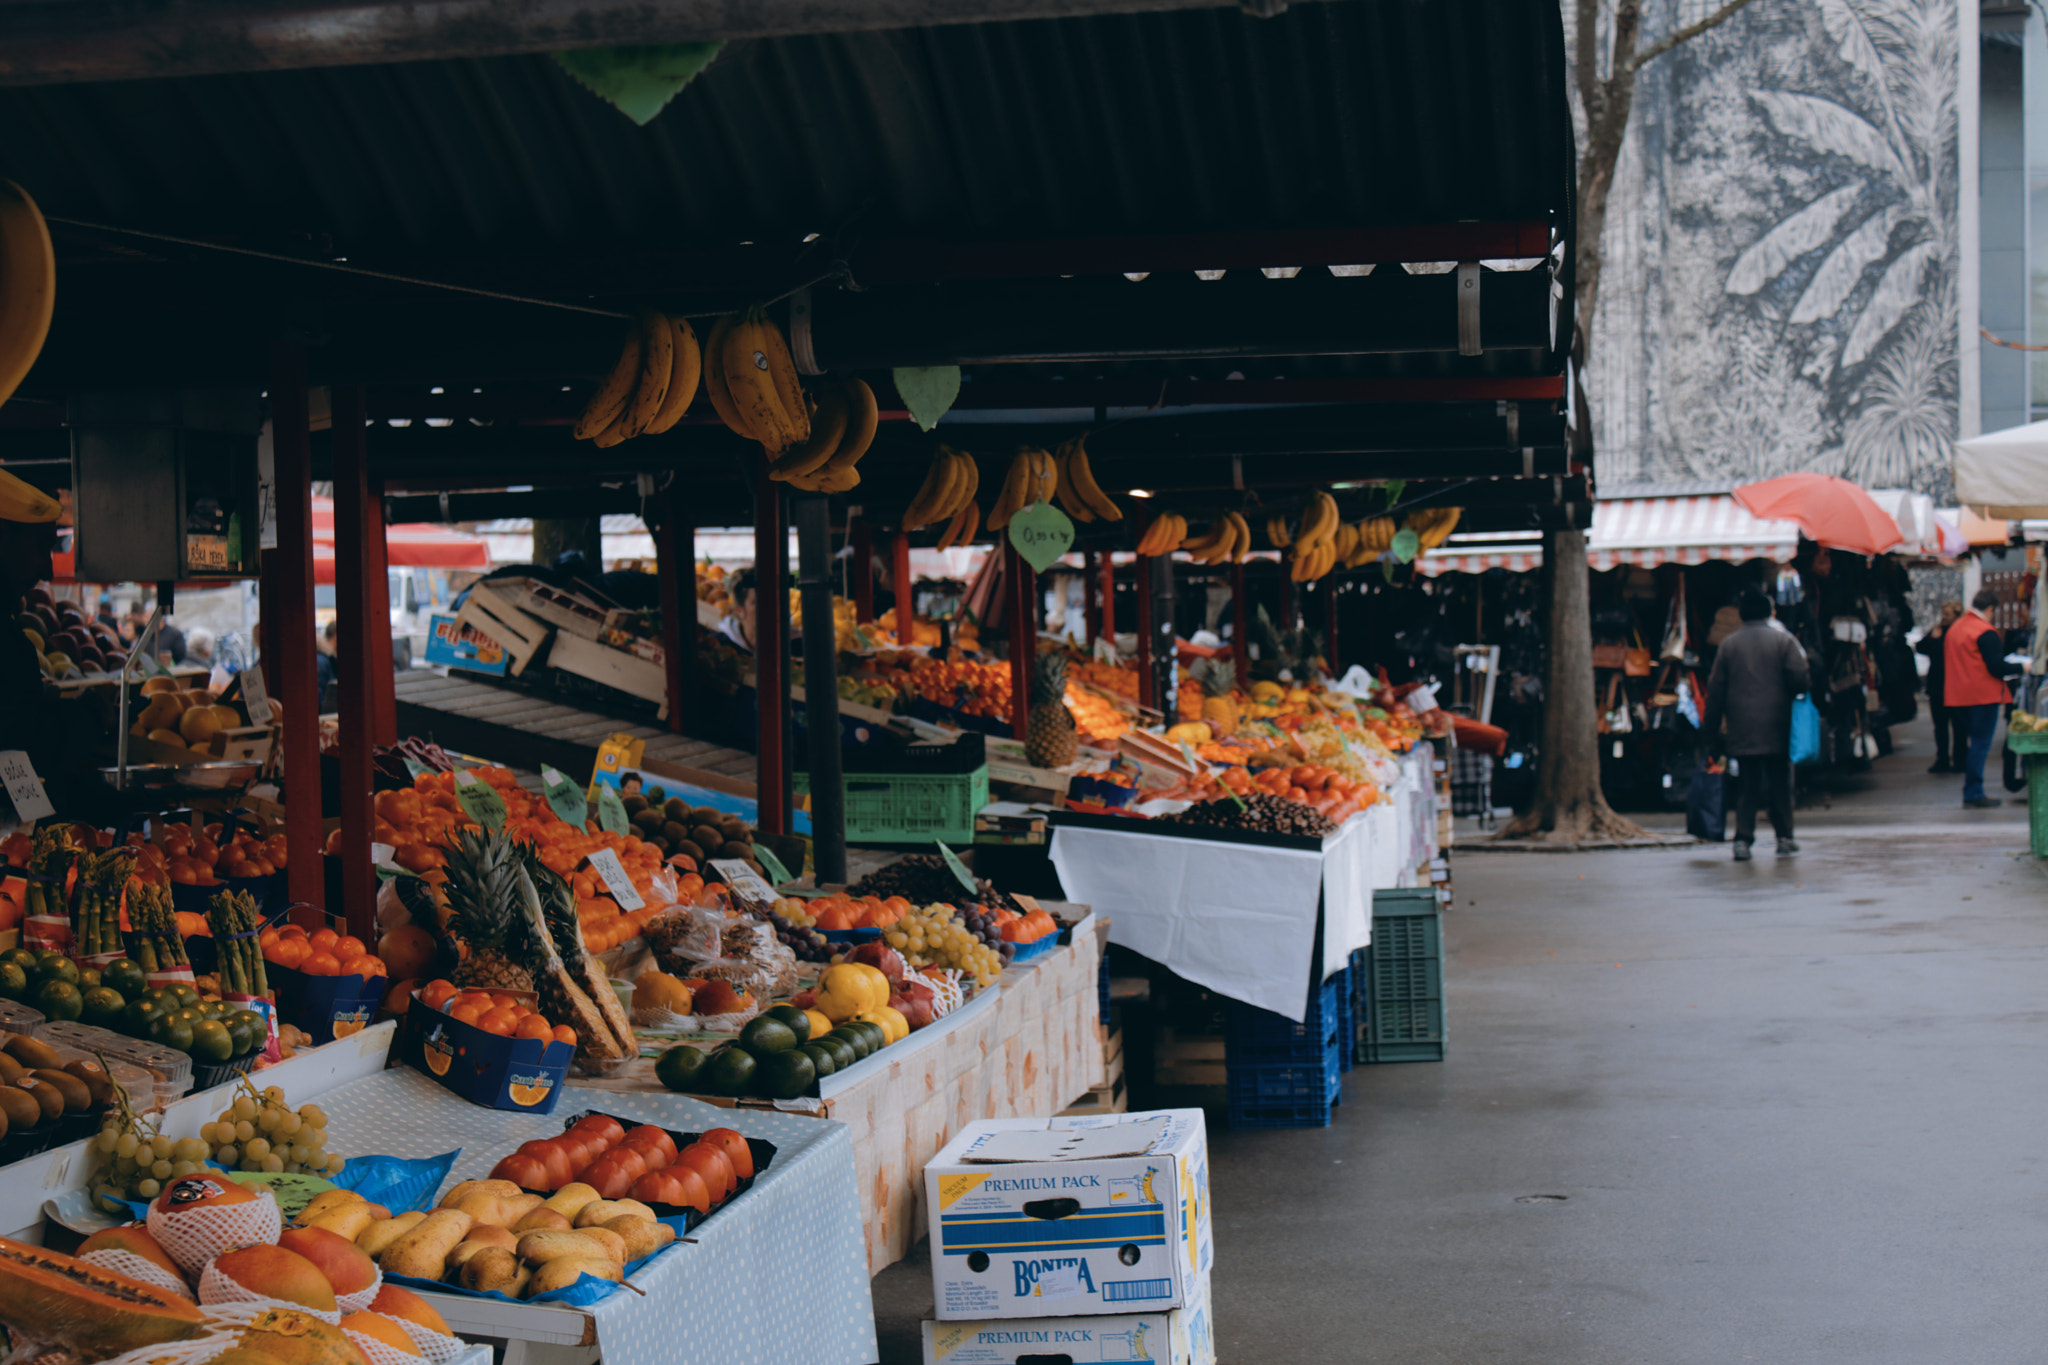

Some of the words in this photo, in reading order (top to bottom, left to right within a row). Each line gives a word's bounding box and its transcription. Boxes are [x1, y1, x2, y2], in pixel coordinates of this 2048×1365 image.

[984, 1177, 1056, 1193] PREMIUM
[1062, 1175, 1101, 1189] PACK
[978, 1330, 1048, 1345] PREMIUM
[1054, 1329, 1093, 1343] PACK
